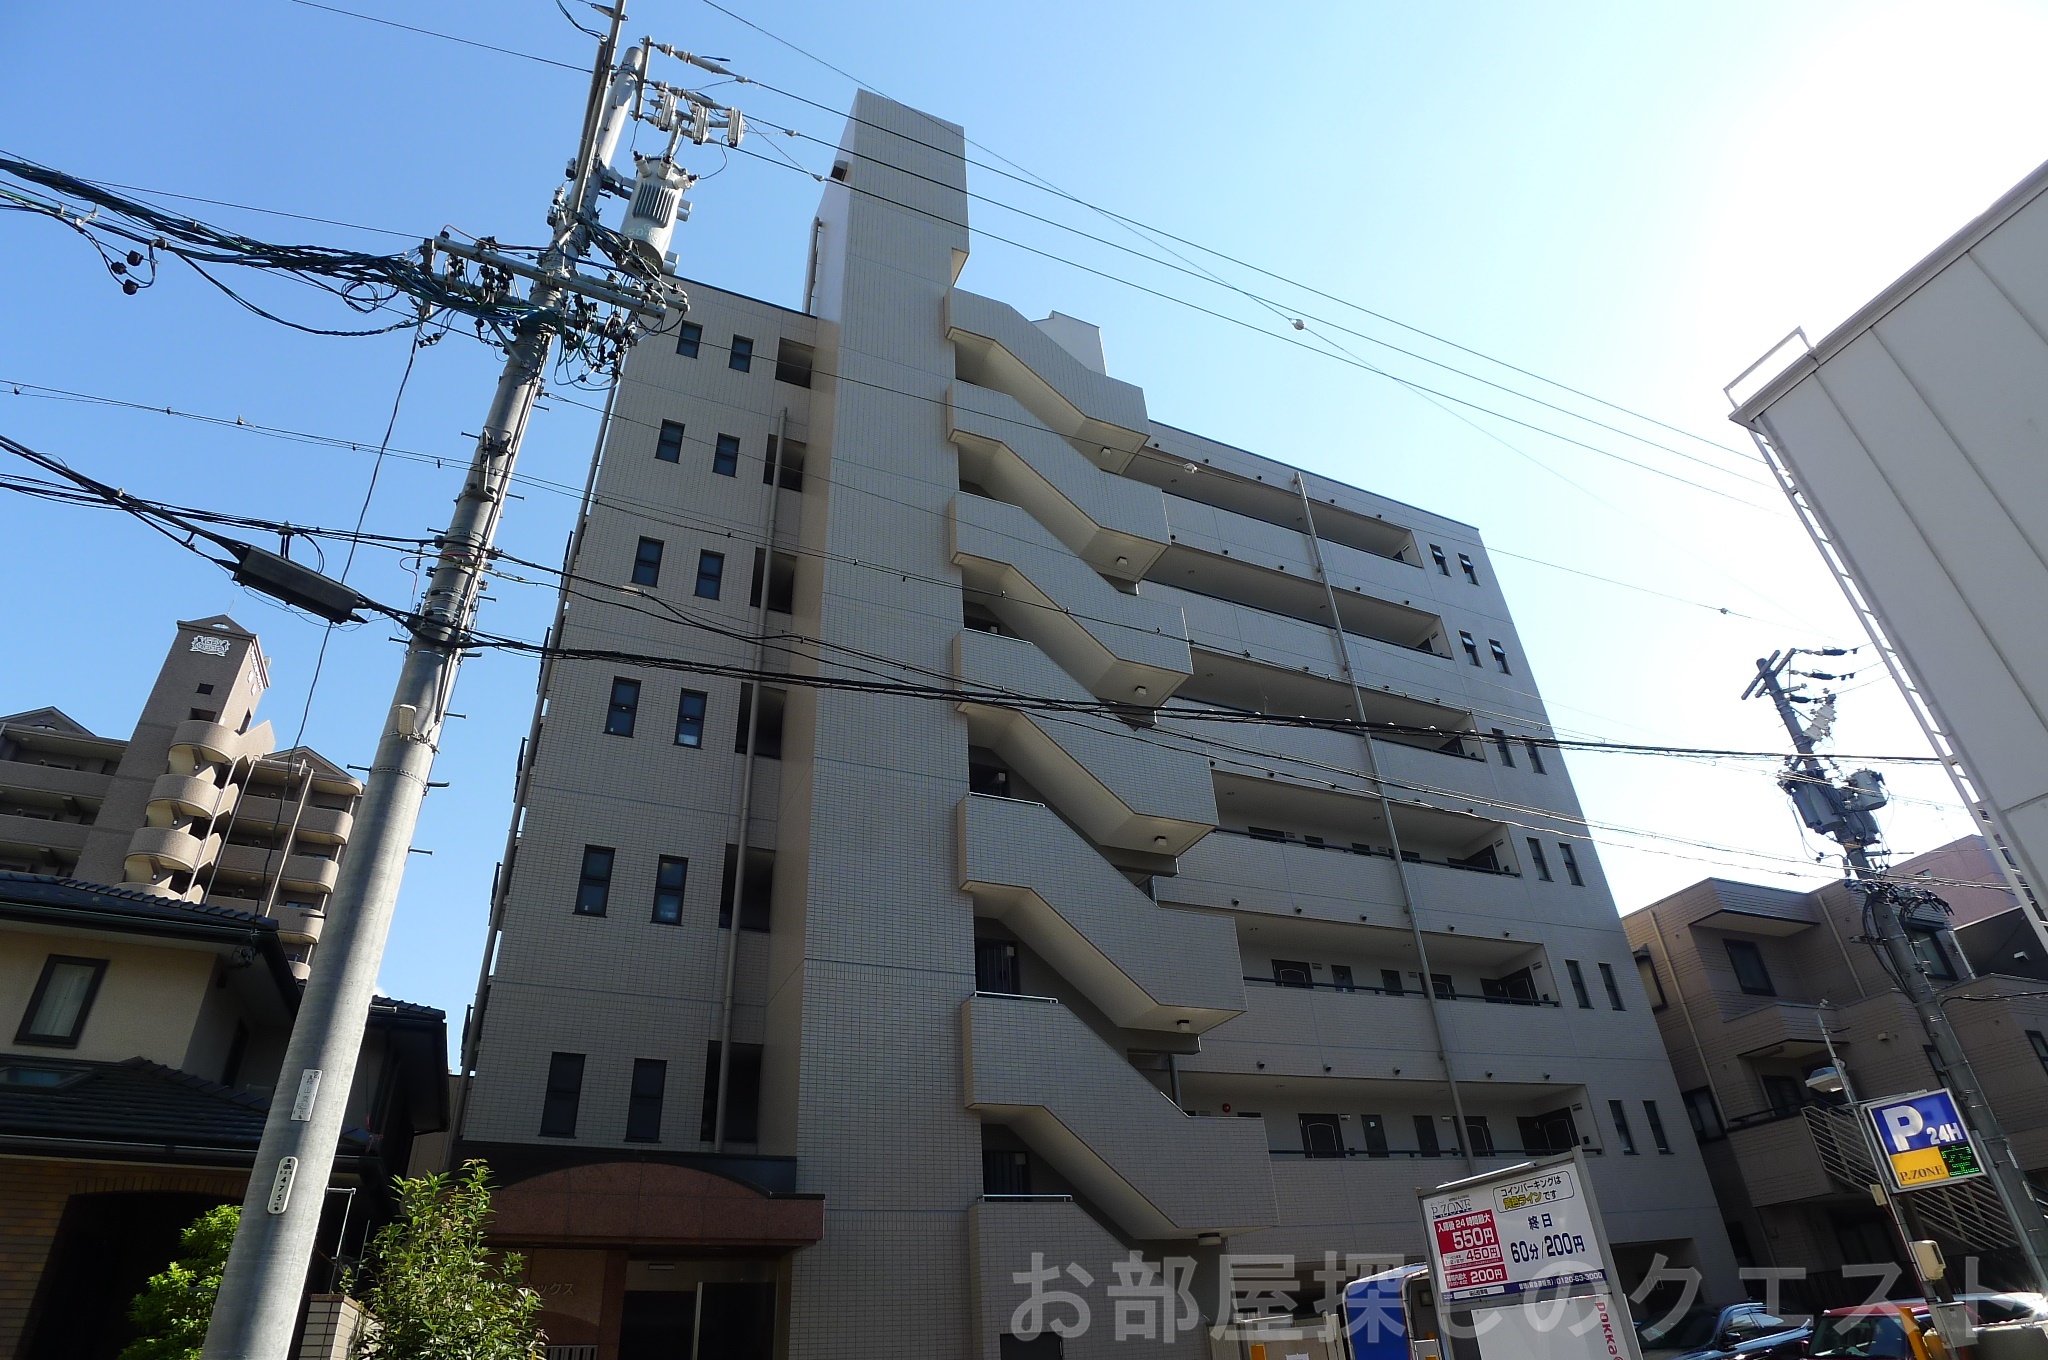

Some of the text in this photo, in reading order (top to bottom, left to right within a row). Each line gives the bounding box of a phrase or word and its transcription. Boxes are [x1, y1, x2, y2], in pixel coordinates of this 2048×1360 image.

[1882, 1105, 1963, 1152] P 24H
[1899, 1164, 1945, 1182] P.ZONE
[1527, 1212, 1553, 1231] 終日
[1452, 1227, 1495, 1250] 550円
[1510, 1232, 1586, 1264] 60分/200円
[1466, 1247, 1498, 1261] 450円
[1470, 1268, 1503, 1284] 200円
